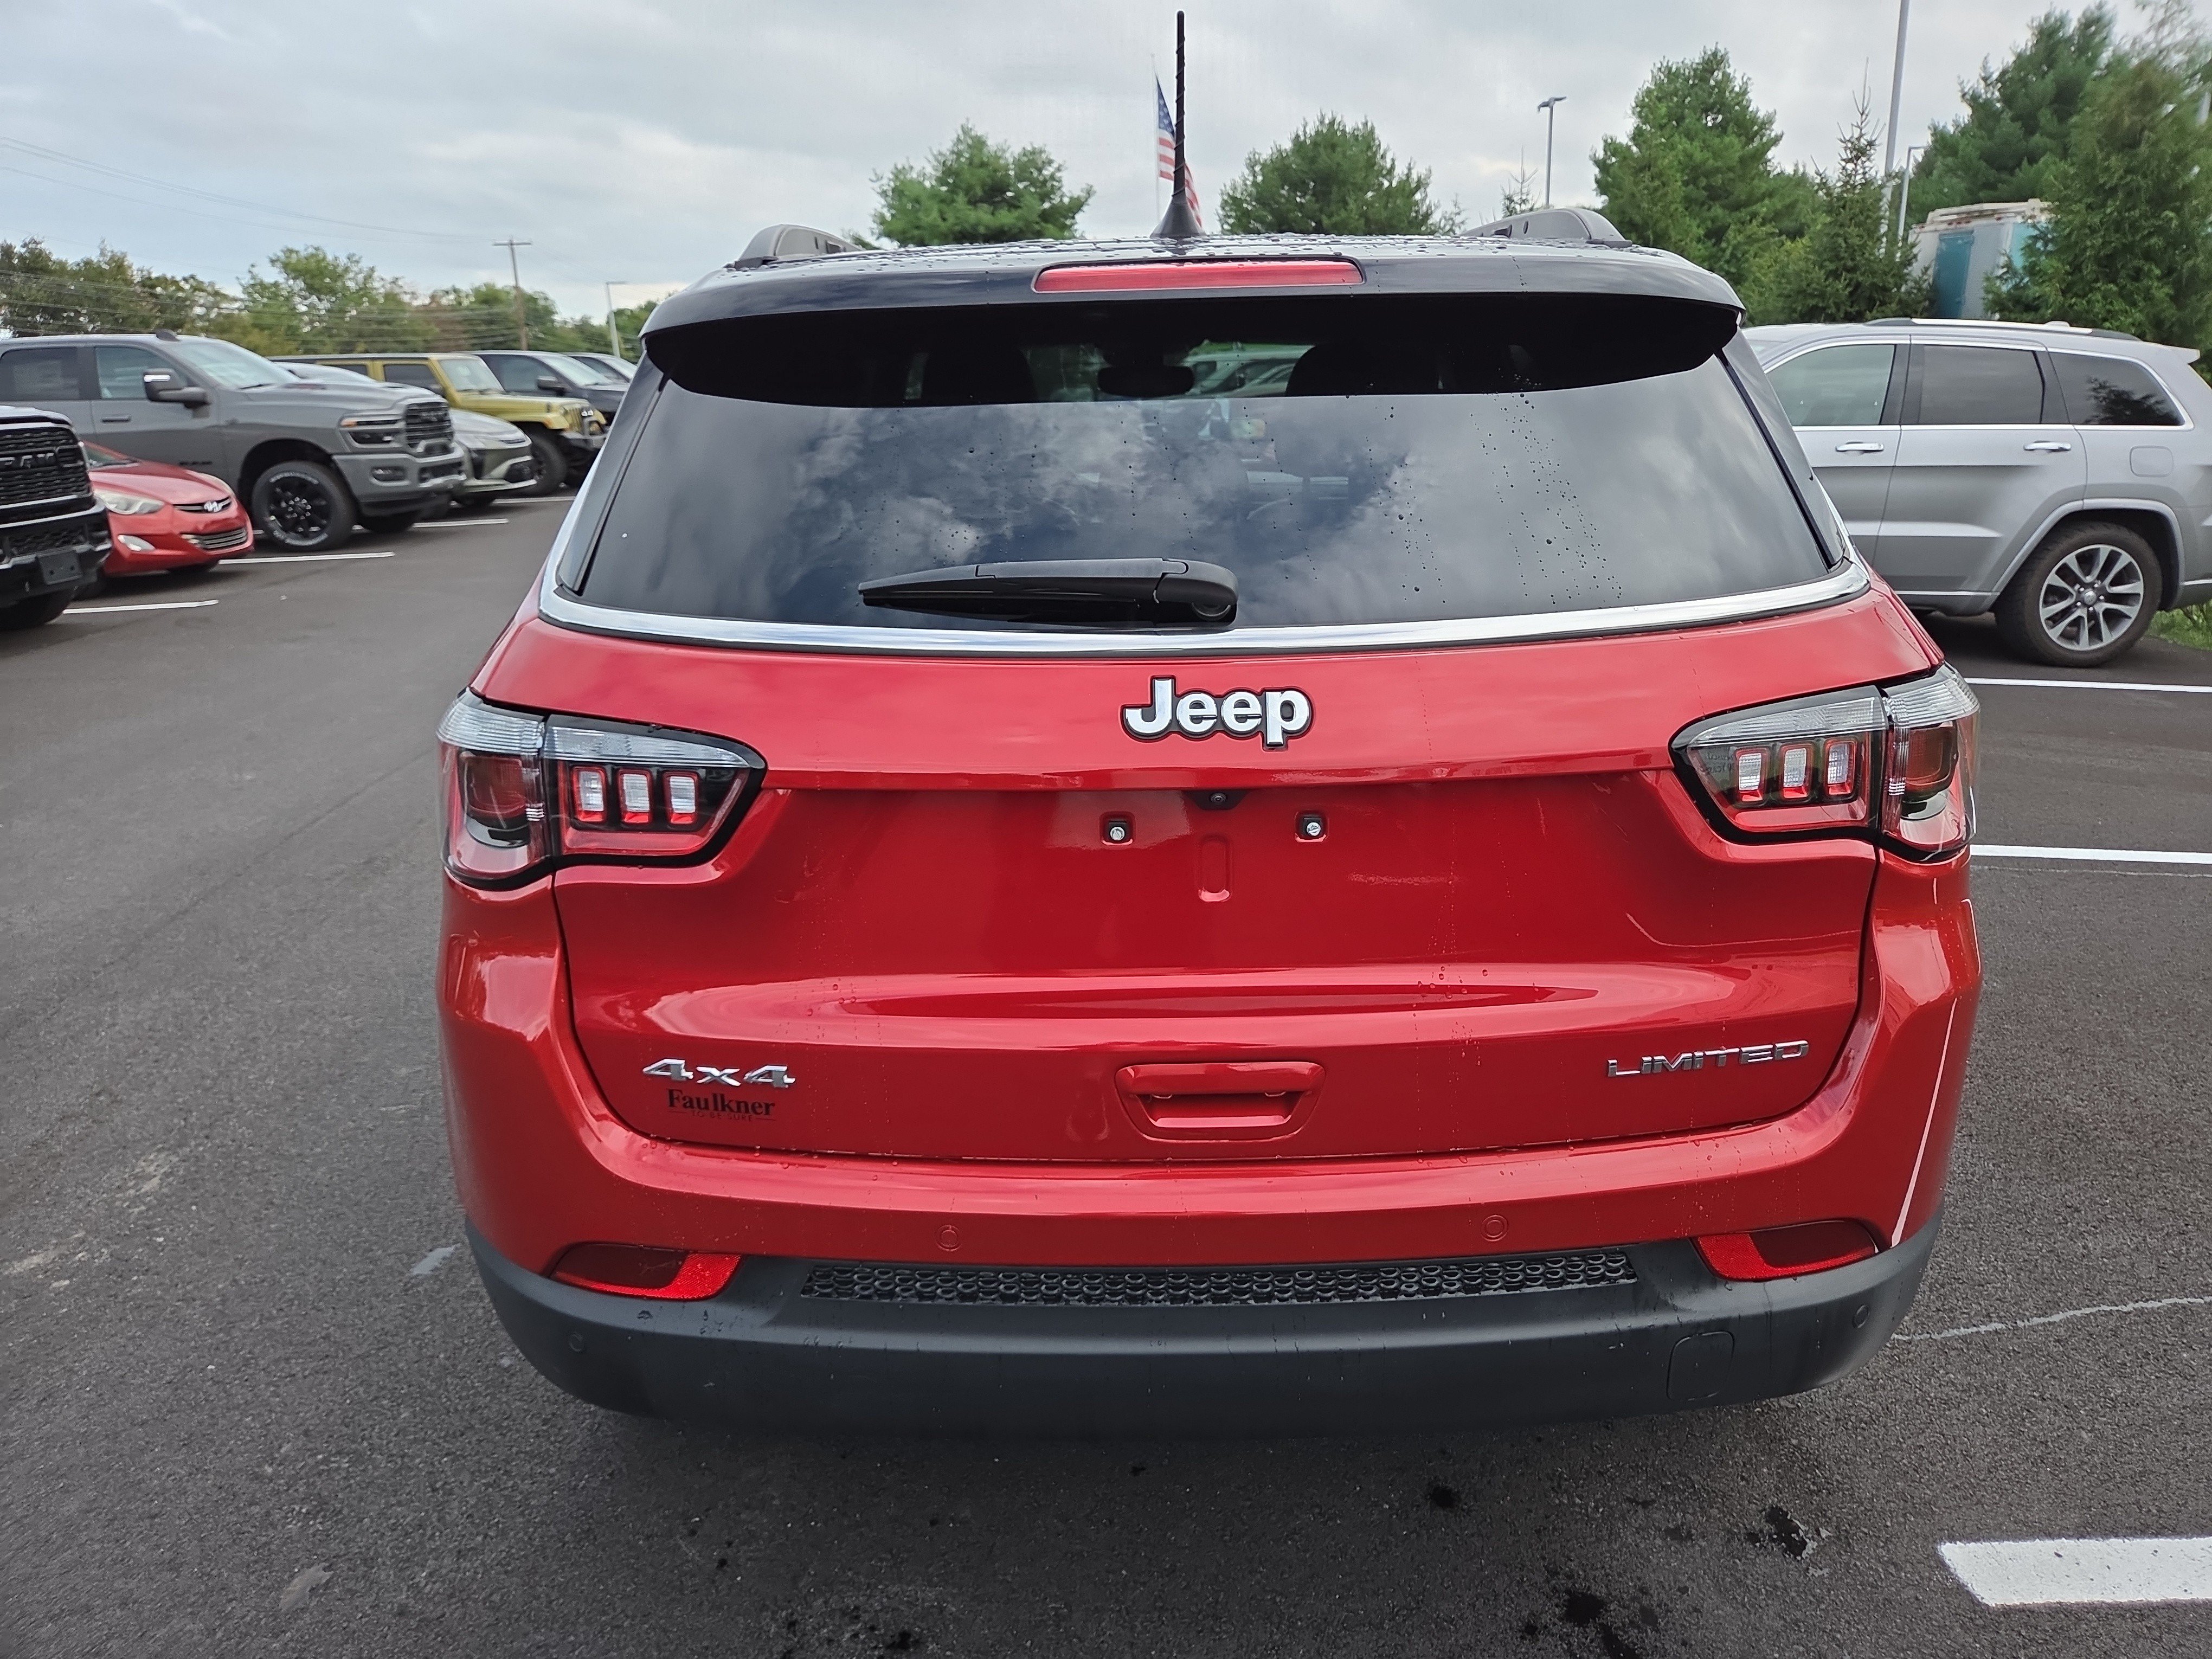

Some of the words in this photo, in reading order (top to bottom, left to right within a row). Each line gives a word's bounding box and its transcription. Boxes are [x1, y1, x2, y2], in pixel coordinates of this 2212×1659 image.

[1123, 676, 1313, 750] Jeep
[642, 1058, 796, 1088] 4x4
[1606, 1040, 1809, 1077] LIMITED
[667, 1089, 775, 1116] Faulkner
[727, 1113, 753, 1122] SURE
